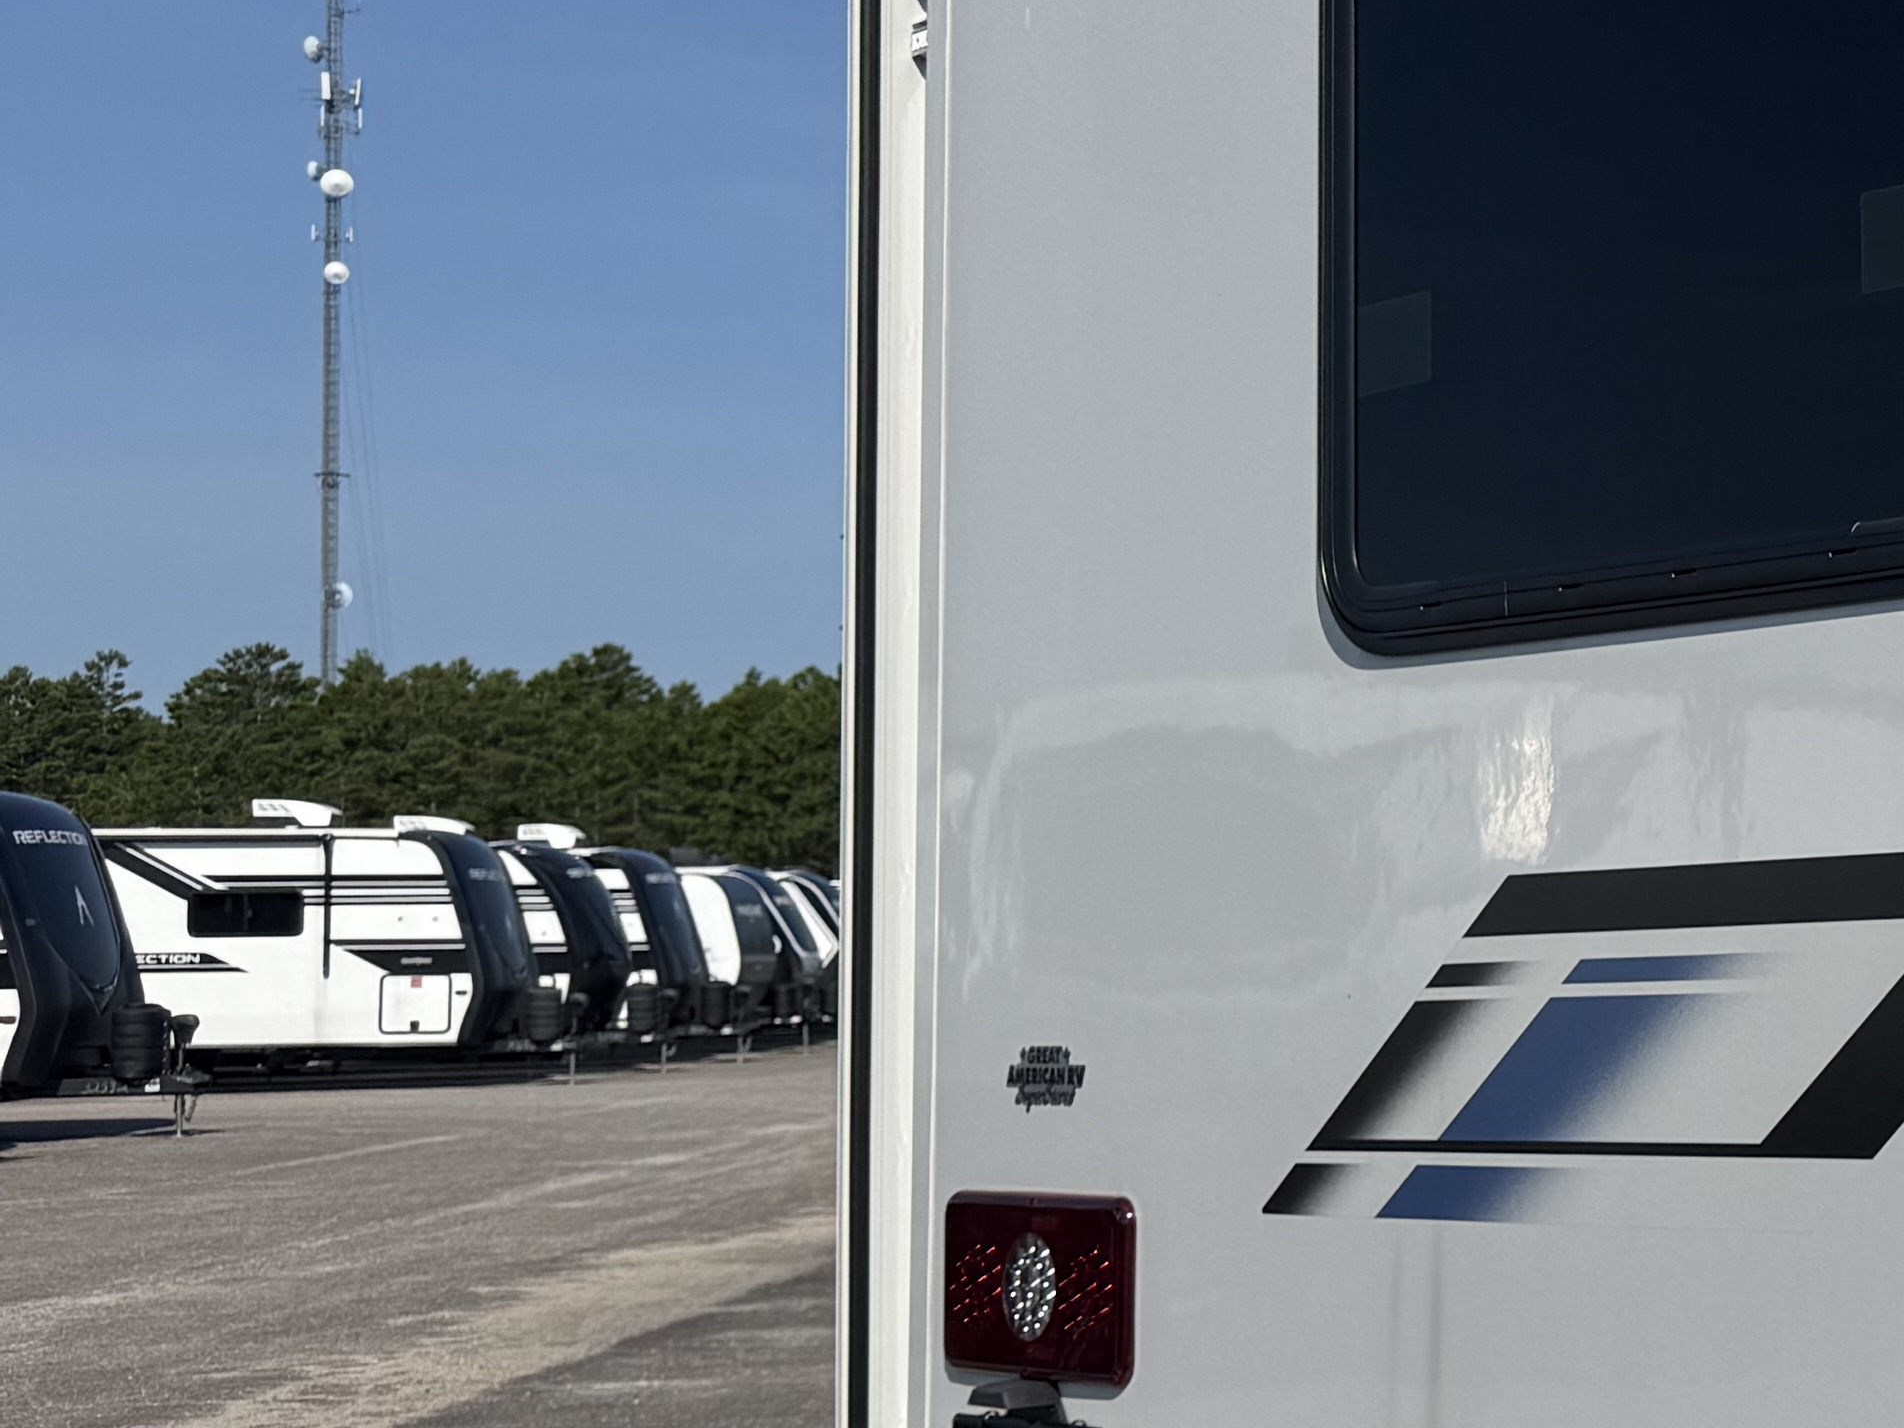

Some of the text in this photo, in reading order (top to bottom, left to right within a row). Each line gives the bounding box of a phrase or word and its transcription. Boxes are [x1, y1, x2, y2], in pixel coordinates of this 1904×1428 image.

[1027, 1046, 1063, 1064] GREAT
[1006, 1064, 1086, 1089] AMERICAN RV
